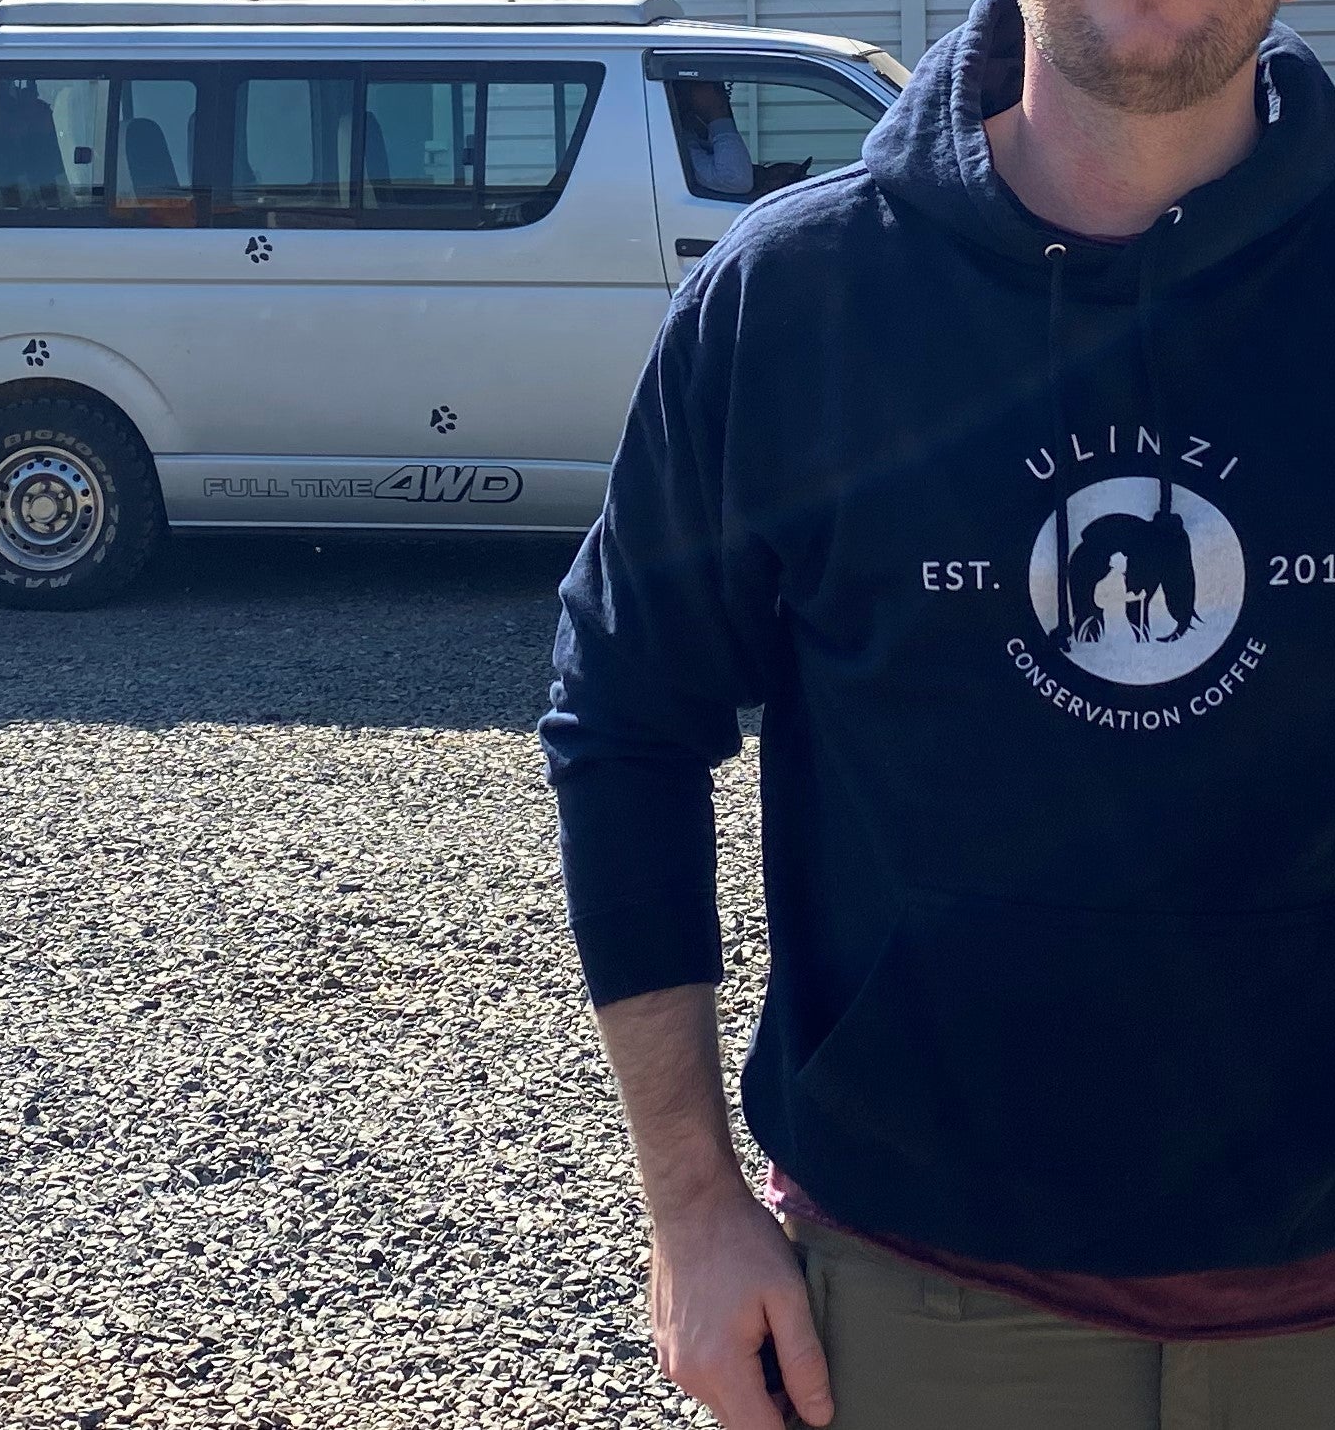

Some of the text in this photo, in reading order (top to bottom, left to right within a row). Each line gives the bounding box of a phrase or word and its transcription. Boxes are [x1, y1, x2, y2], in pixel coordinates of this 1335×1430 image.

[3, 429, 116, 493] BIGHORN
[1025, 425, 1239, 480] ULINZI
[203, 464, 524, 503] FULL TIME 4WD
[922, 559, 1001, 591] EST.
[1006, 636, 1268, 731] CONSERVATION COFFEE
